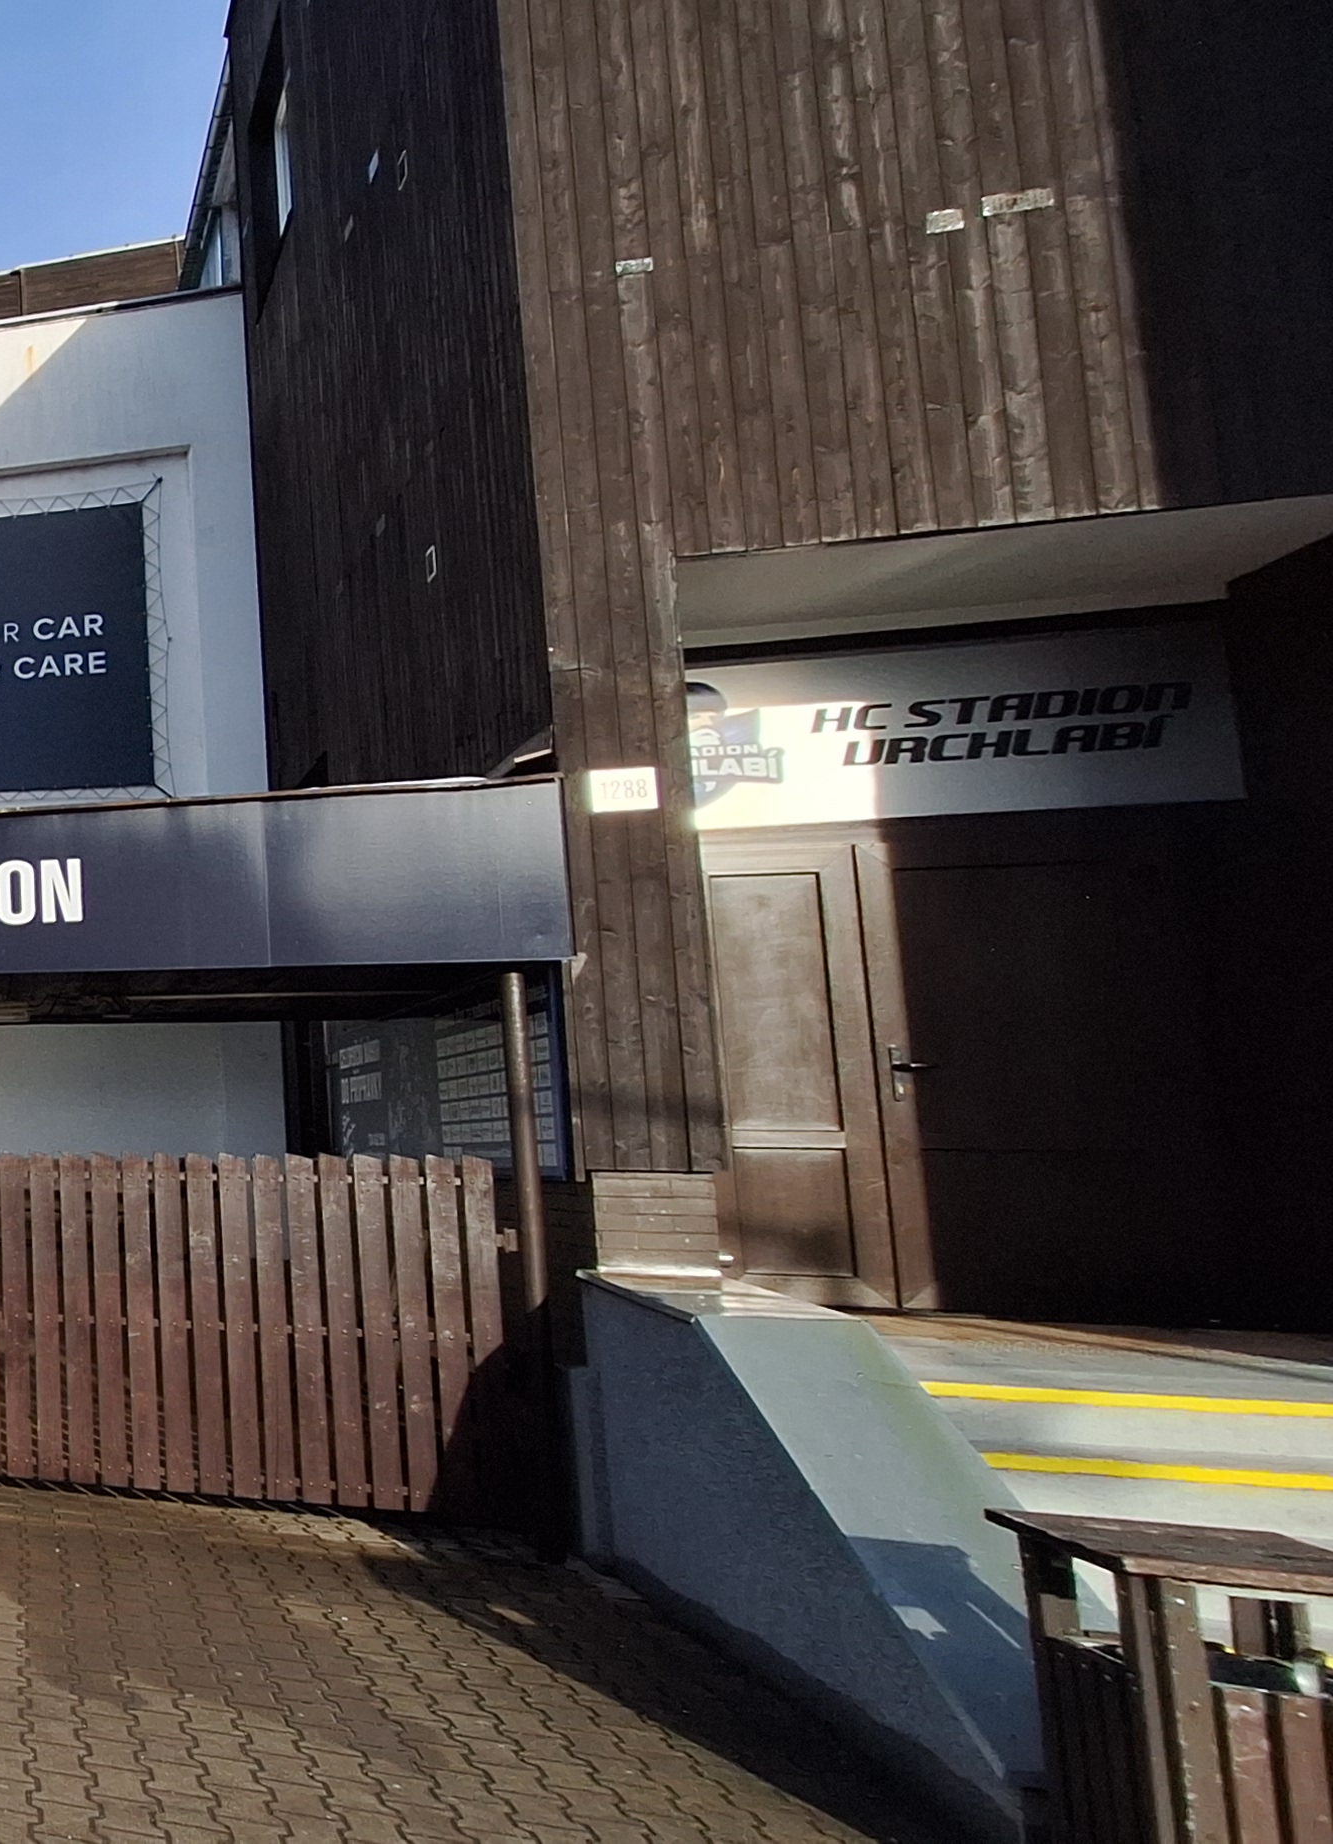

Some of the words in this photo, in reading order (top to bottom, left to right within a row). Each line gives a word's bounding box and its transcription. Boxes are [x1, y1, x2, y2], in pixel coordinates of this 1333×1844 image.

[33, 613, 104, 641] CAR
[13, 650, 108, 680] CARE
[811, 703, 893, 733] HC
[903, 681, 1193, 729] STADION
[600, 778, 649, 800] 1288
